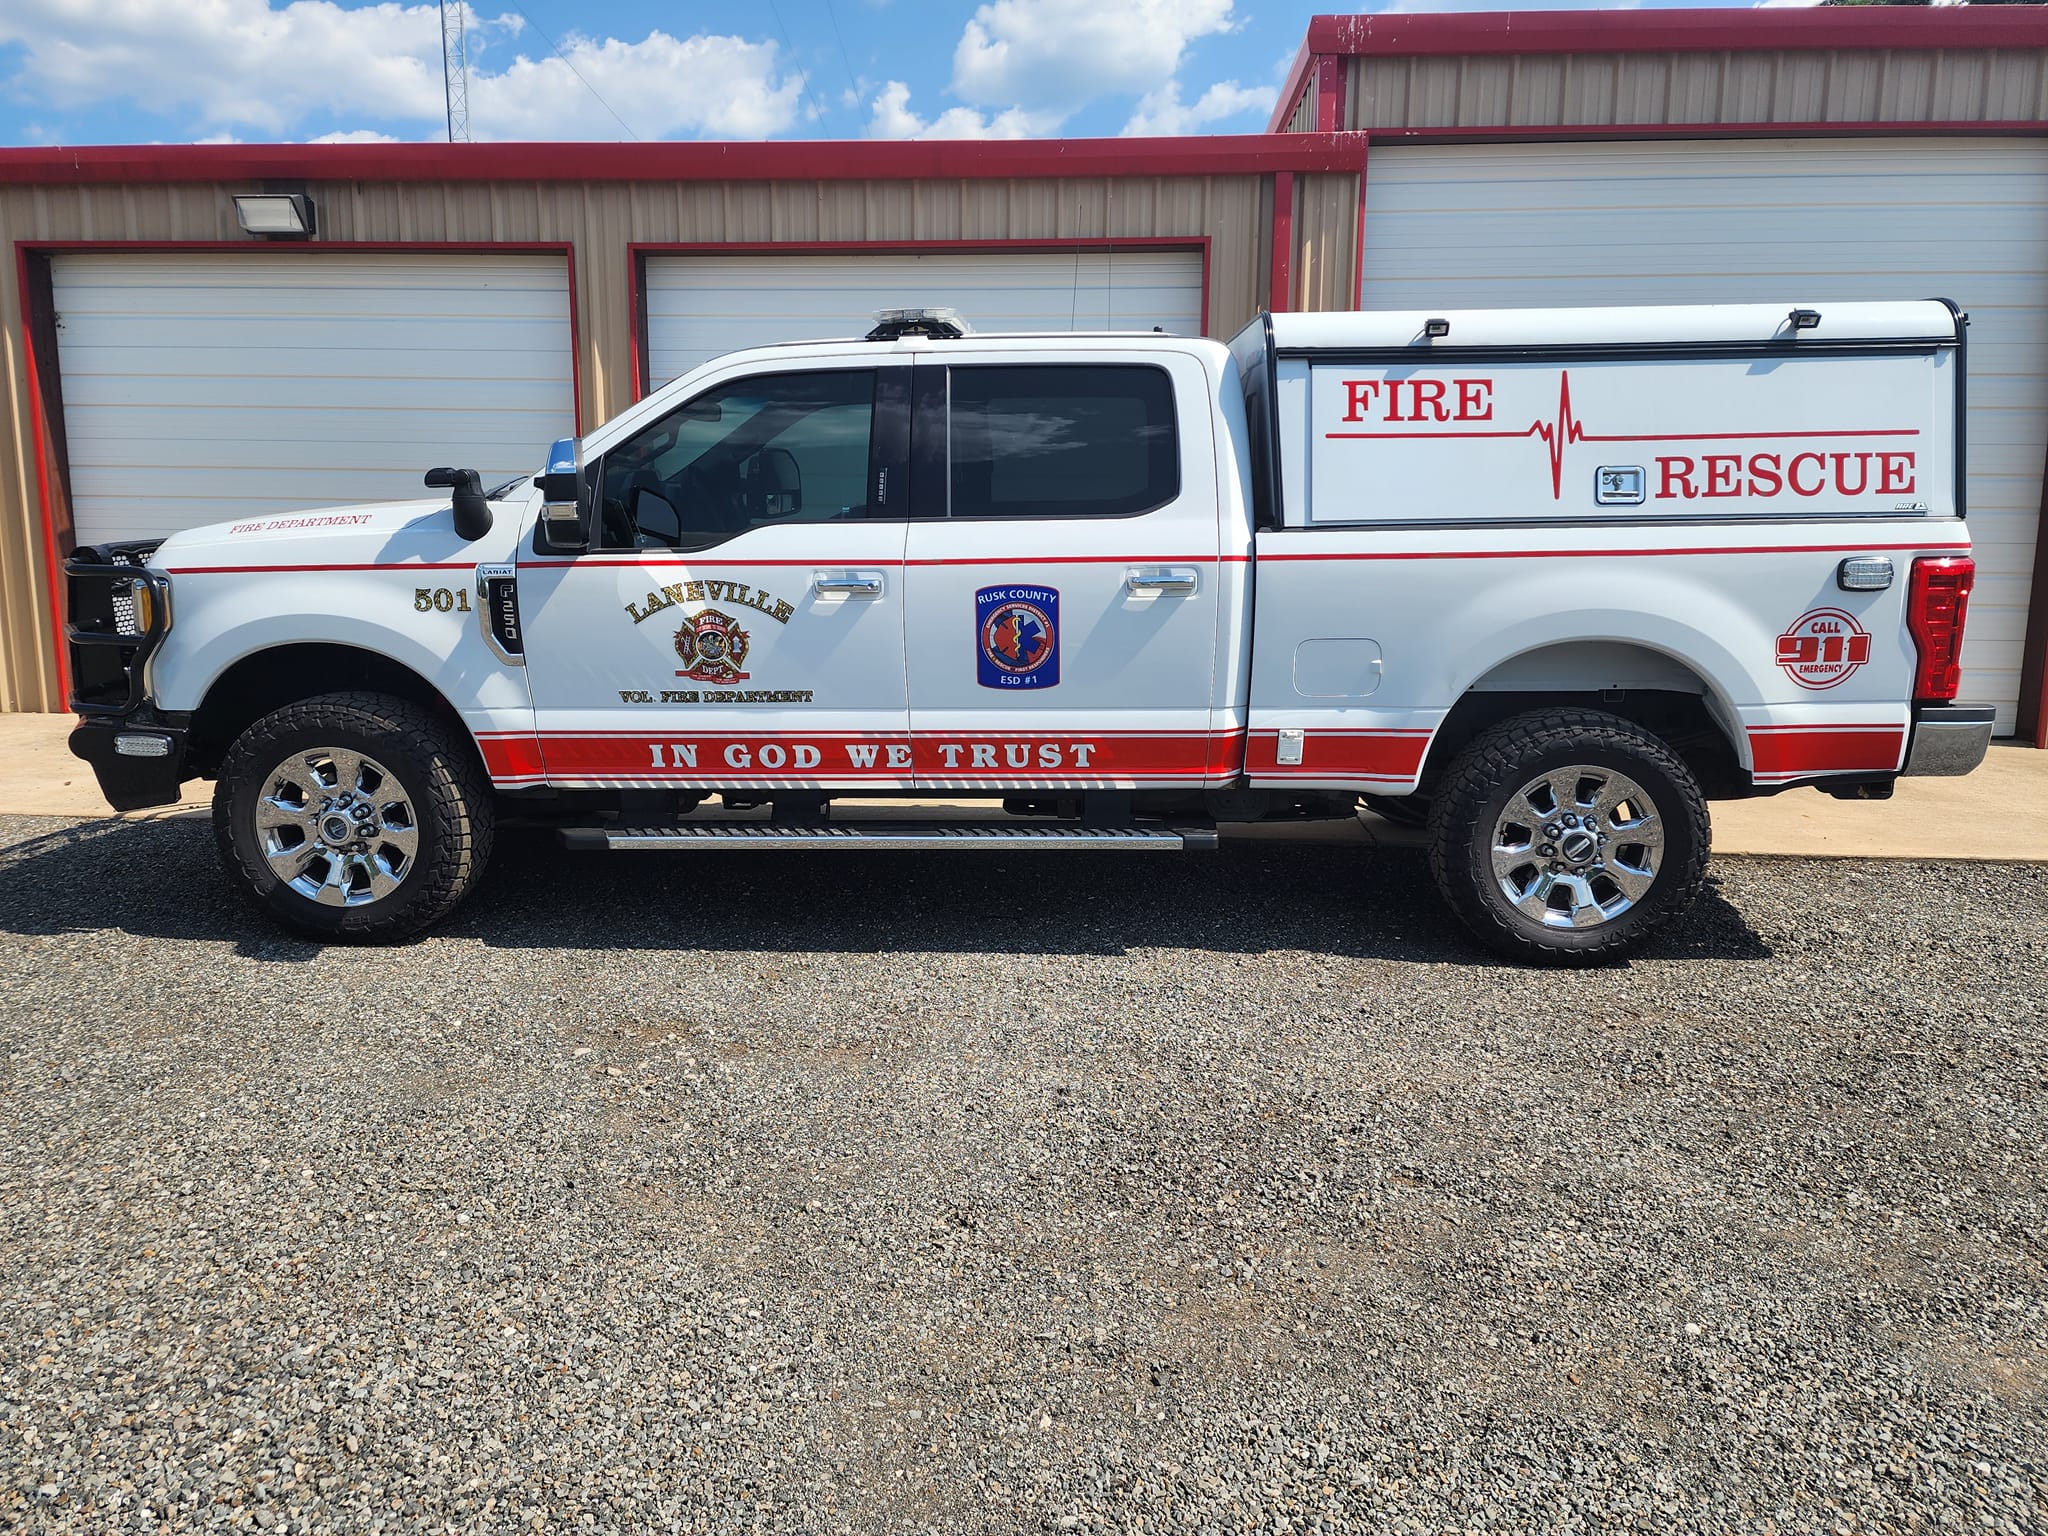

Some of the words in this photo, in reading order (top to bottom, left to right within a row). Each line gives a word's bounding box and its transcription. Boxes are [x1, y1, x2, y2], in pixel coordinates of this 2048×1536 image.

[1342, 379, 1493, 422] FIRE
[1655, 452, 1915, 499] RESCUE
[230, 522, 265, 534] FIRE
[267, 514, 373, 530] DEPARTMENT
[414, 587, 472, 613] 501
[624, 579, 796, 625] LANEVILLE
[977, 590, 1006, 605] RUSK
[1009, 589, 1057, 604] COUNTY
[699, 615, 723, 626] FIRE
[1811, 622, 1841, 634] CALL
[702, 665, 723, 675] DEPT
[1799, 664, 1843, 674] EMERGENCY
[1000, 675, 1020, 685] ESD
[1025, 675, 1037, 685] #1
[619, 690, 656, 704] VOL.
[660, 690, 699, 704] FIRE
[702, 690, 814, 704] DEPARTMENT
[648, 743, 698, 769] IN
[725, 743, 822, 769] GOD
[844, 743, 912, 769] WE
[937, 743, 1097, 769] TRUST
